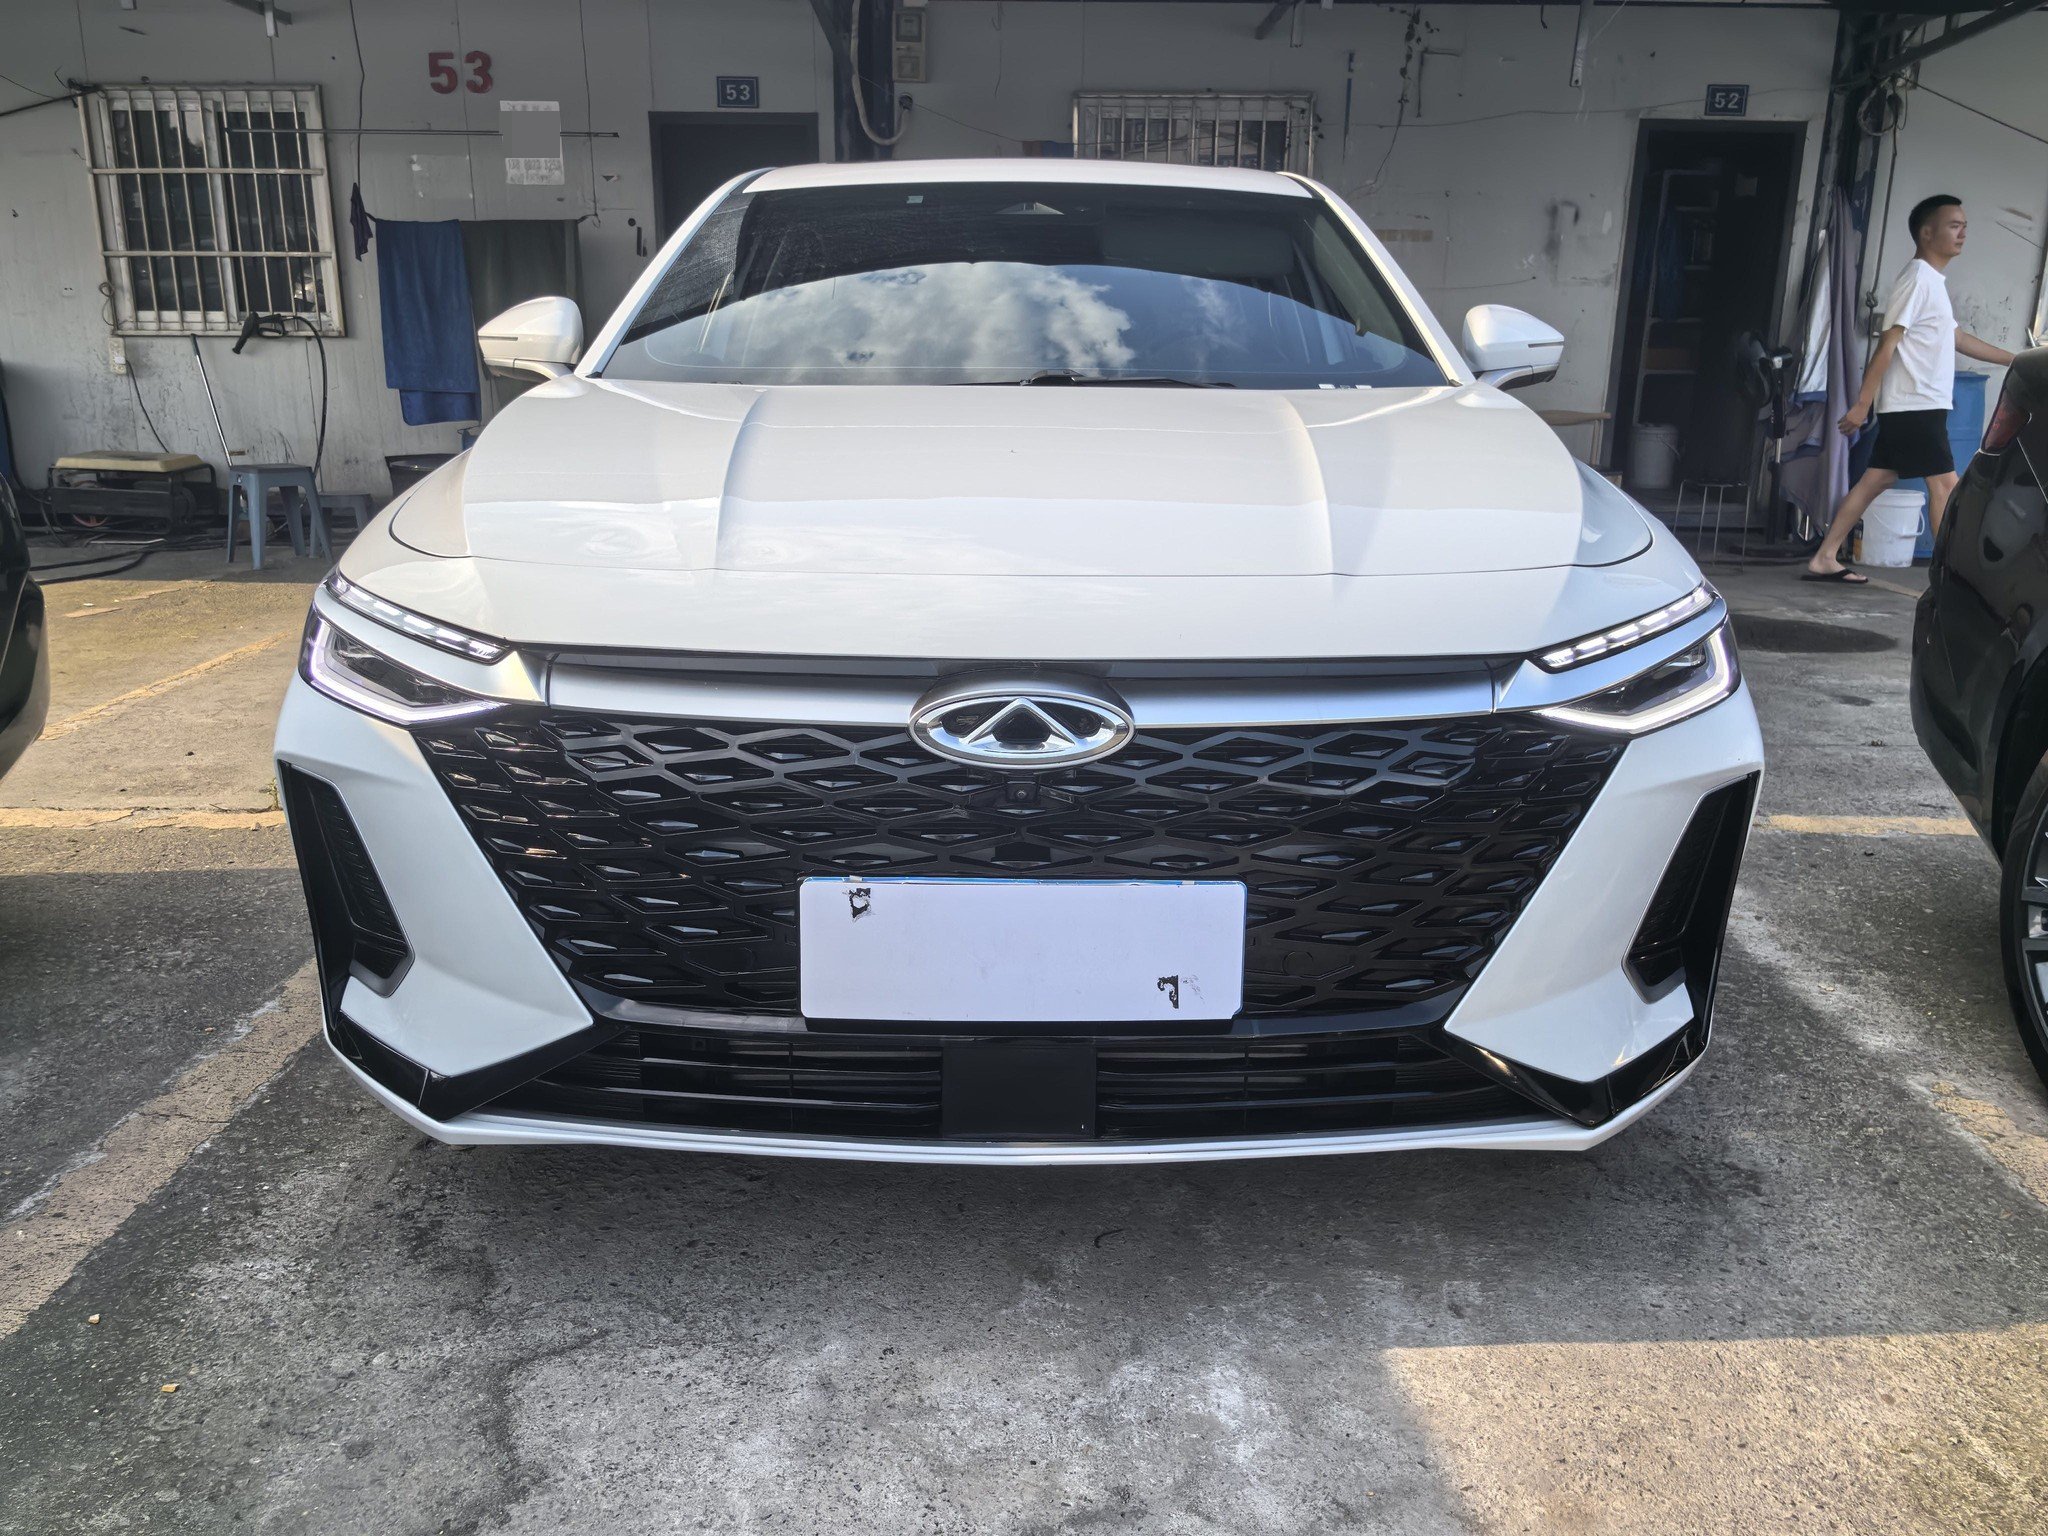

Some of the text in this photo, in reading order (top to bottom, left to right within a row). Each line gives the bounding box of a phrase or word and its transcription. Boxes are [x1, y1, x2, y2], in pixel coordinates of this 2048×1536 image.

[428, 51, 493, 94] 53
[726, 84, 750, 100] 53
[1714, 92, 1739, 108] 52
